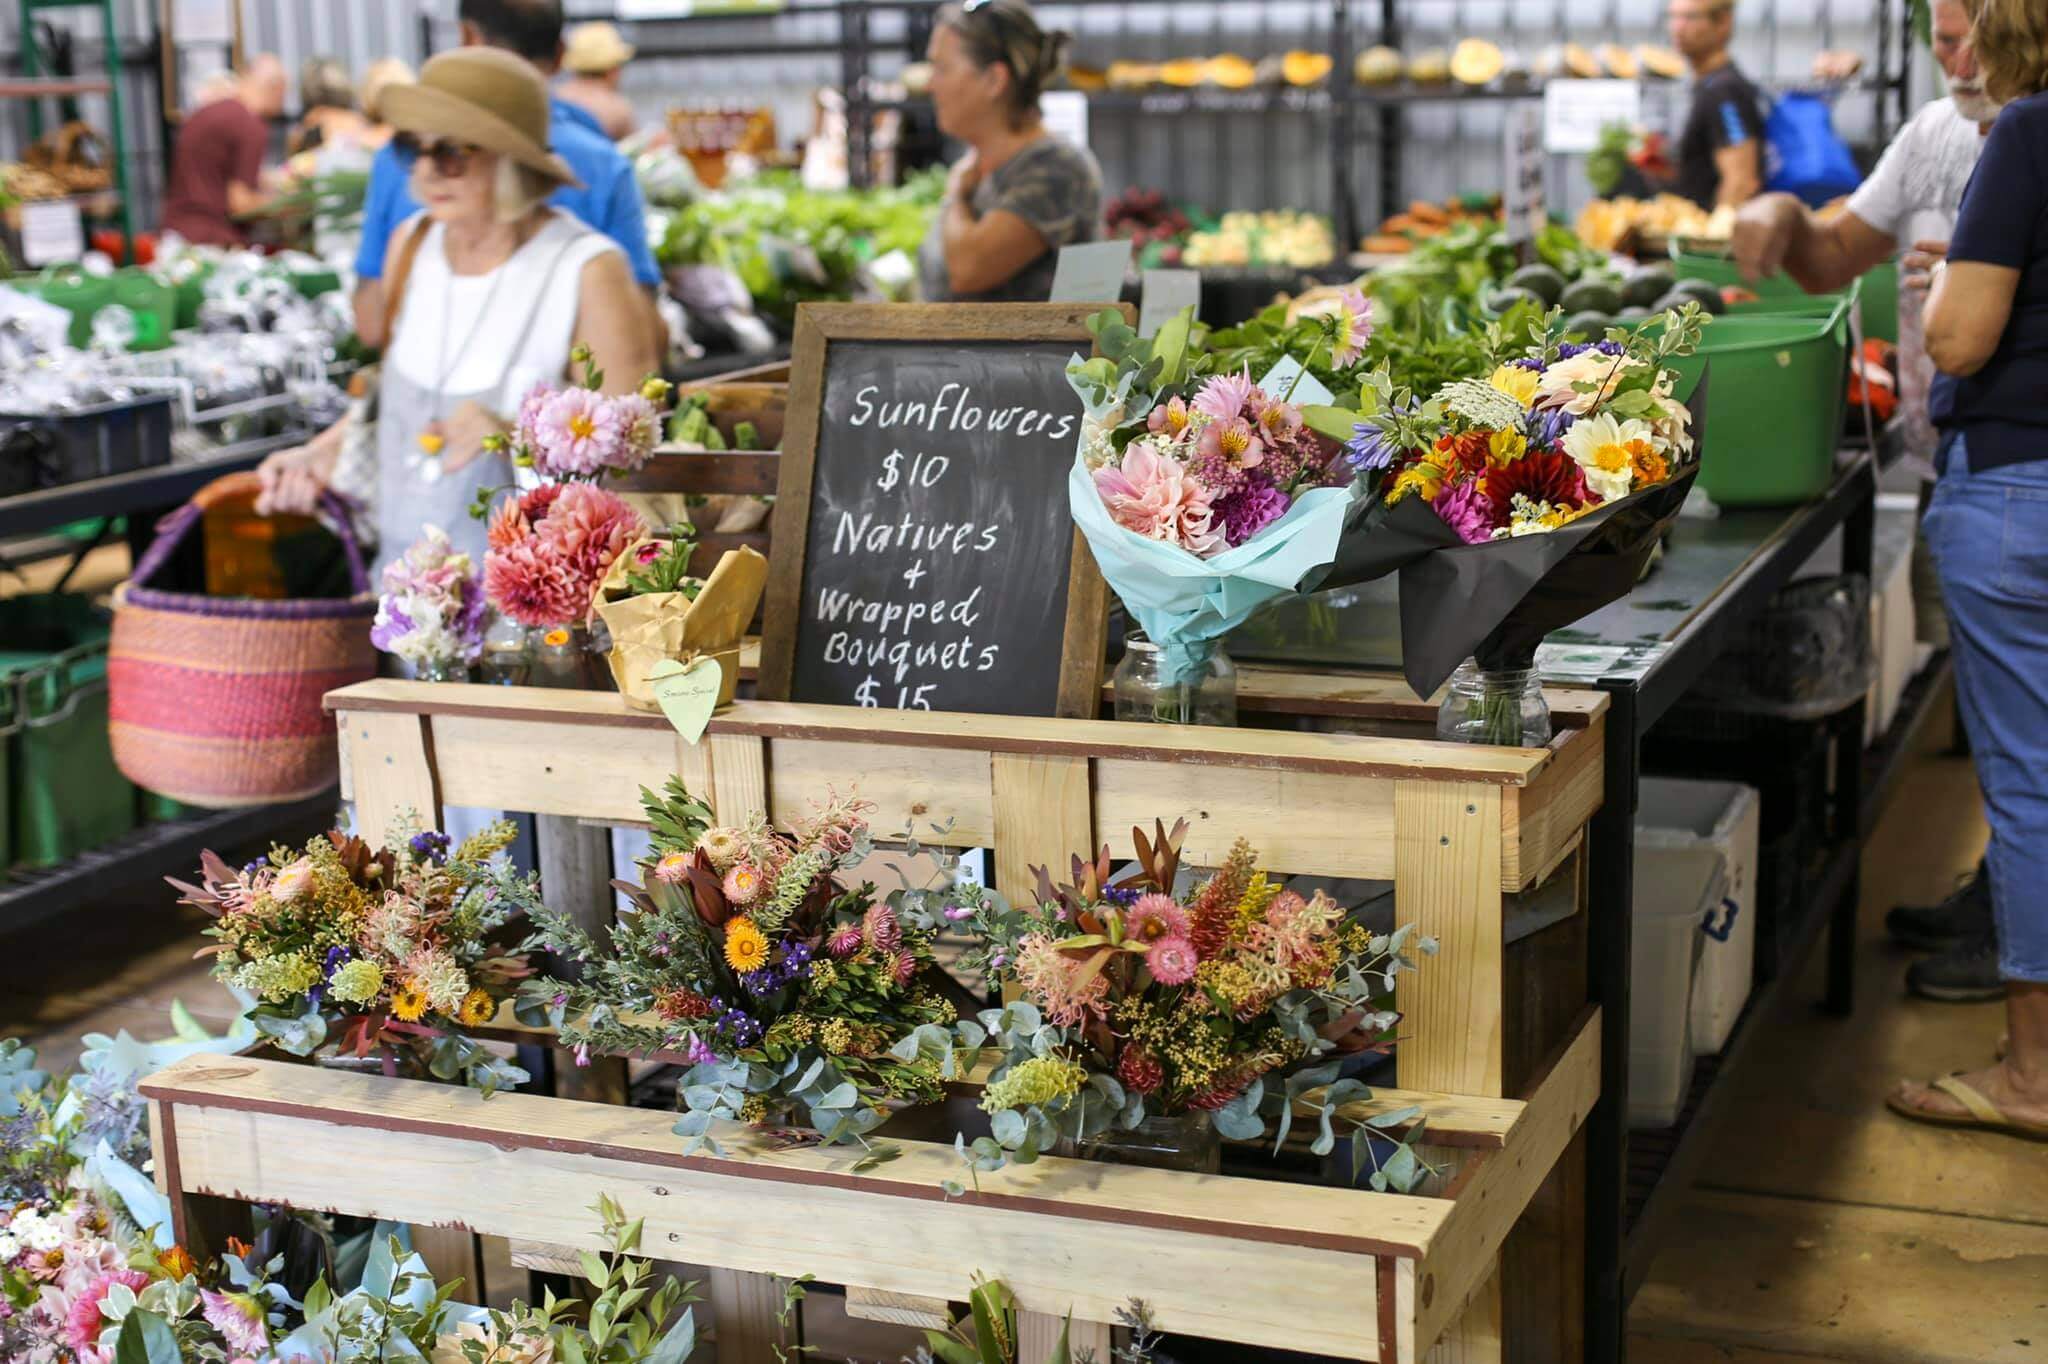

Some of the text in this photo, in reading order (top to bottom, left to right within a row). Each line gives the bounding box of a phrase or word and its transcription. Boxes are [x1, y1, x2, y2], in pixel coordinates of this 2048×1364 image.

[850, 382, 1075, 439] Sunflowers
[877, 449, 949, 491] $10
[832, 511, 998, 555] Natives
[817, 586, 980, 635] Wrapped
[823, 632, 999, 683] Bouquets
